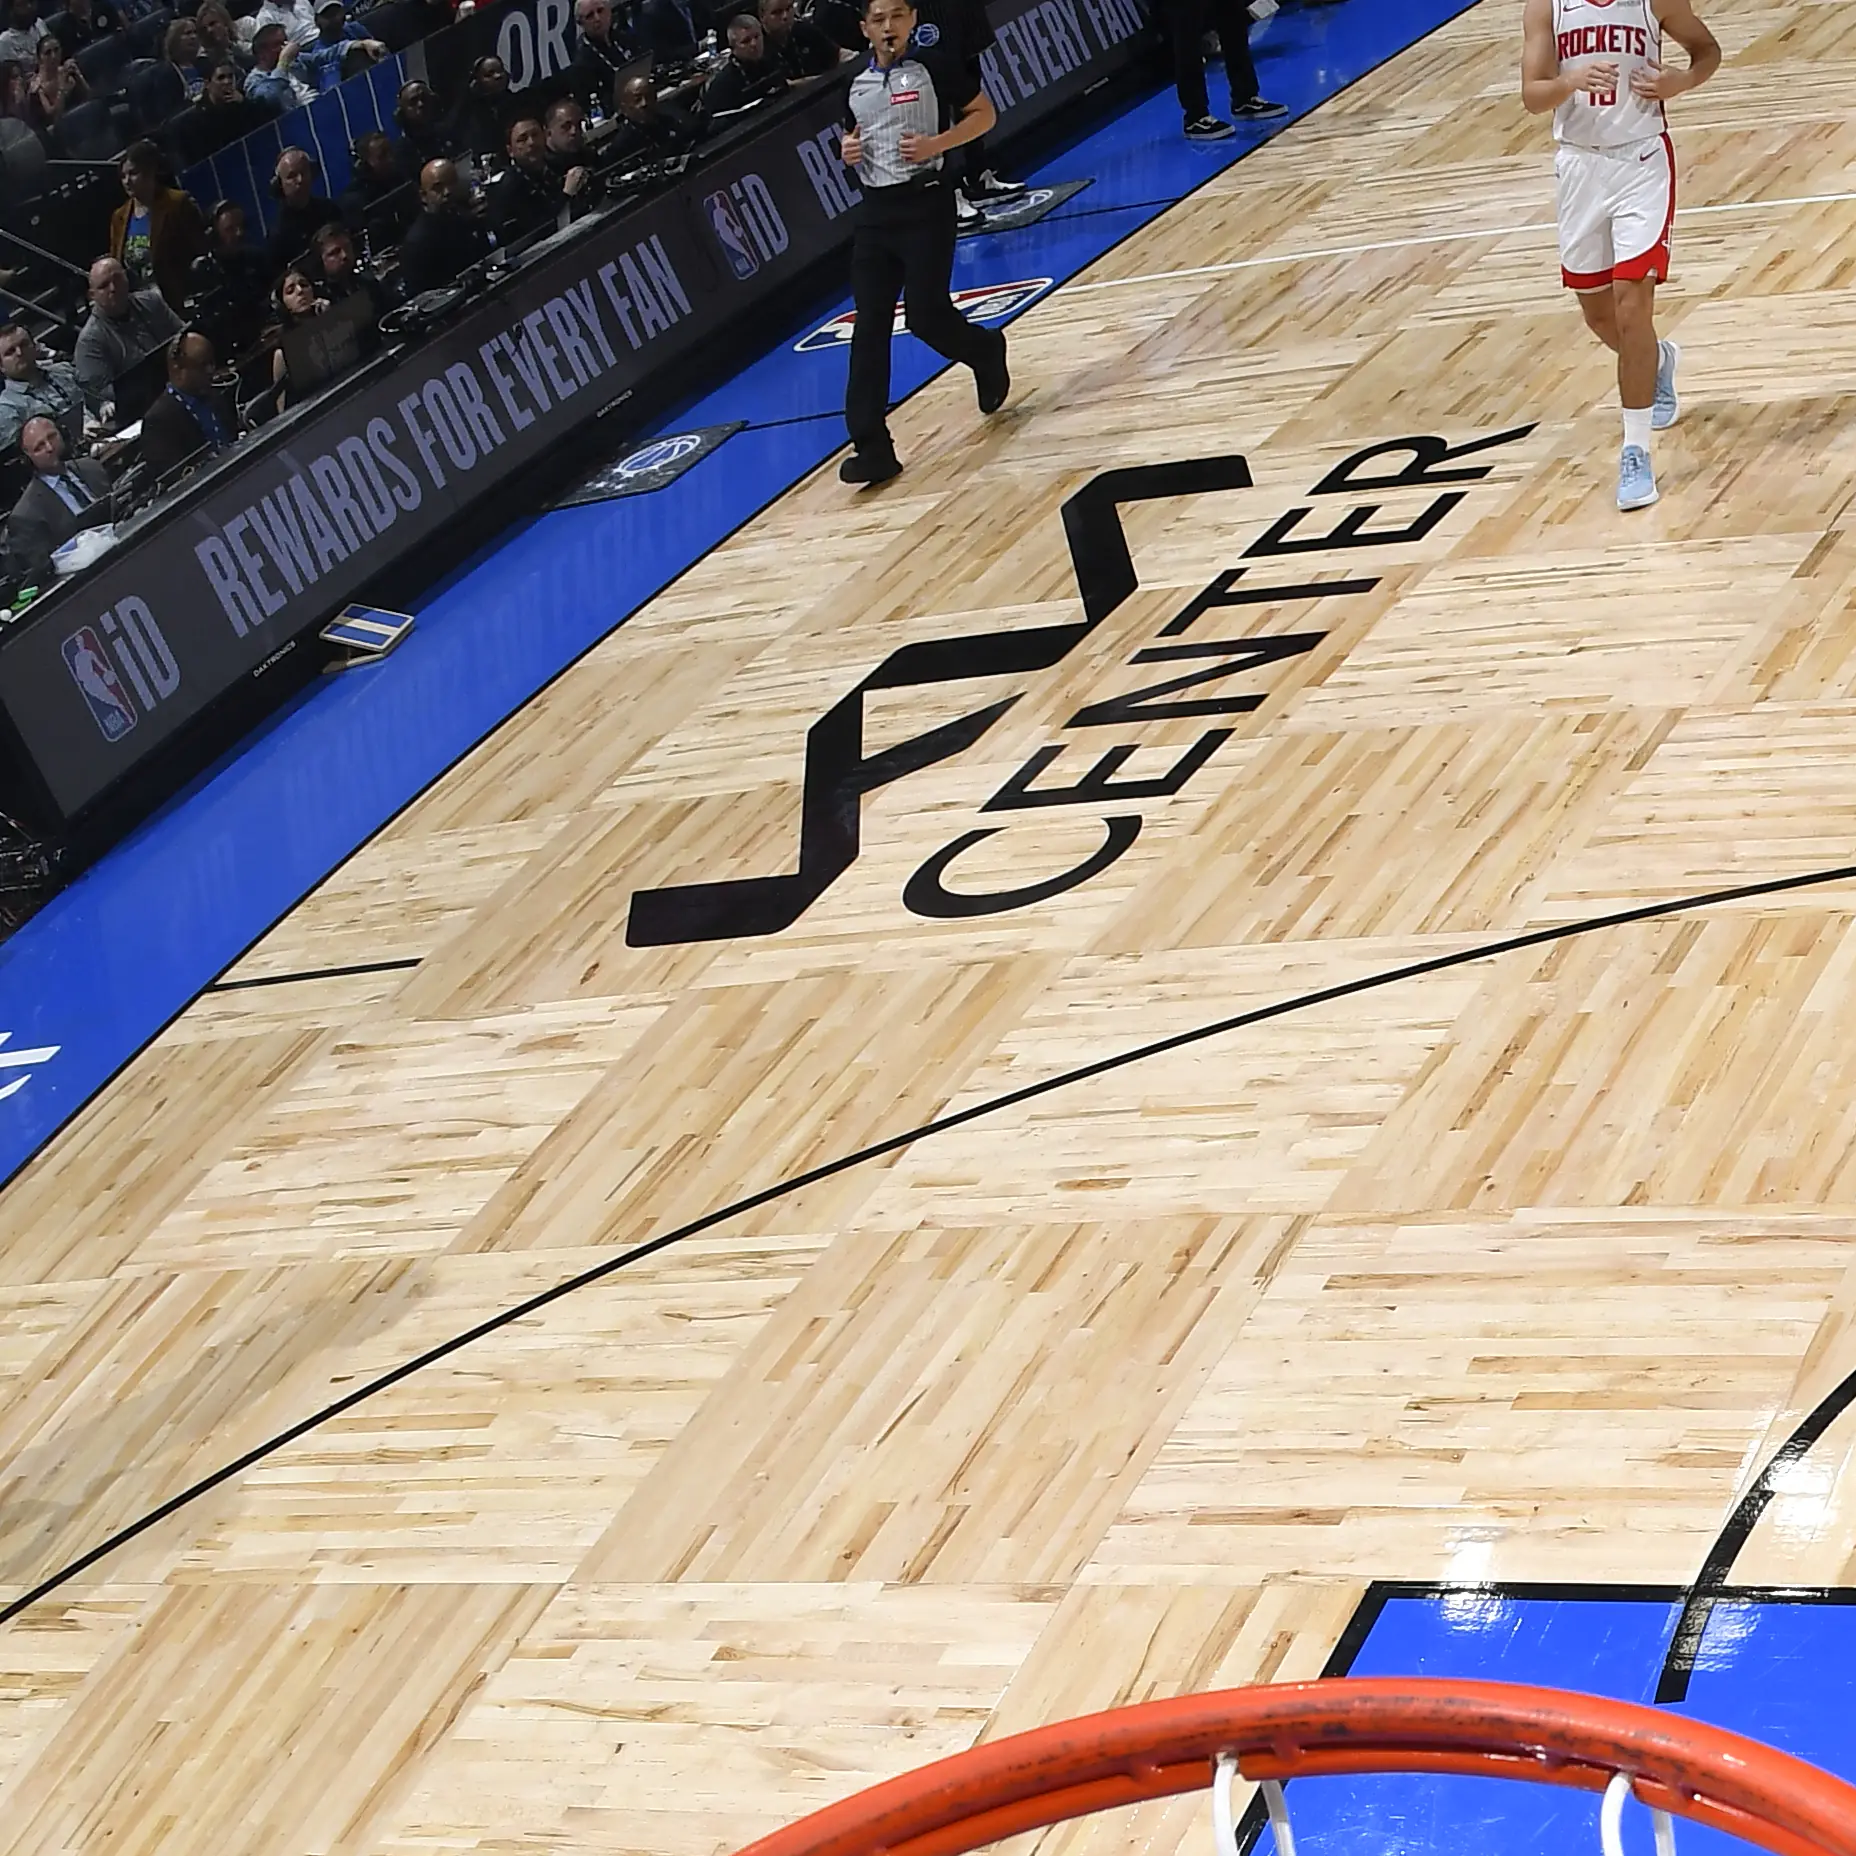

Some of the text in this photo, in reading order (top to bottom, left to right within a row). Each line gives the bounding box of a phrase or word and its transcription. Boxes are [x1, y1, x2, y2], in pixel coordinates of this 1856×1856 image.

[1558, 24, 1647, 60] ROCKETS
[194, 234, 692, 637] REWARDS FOR EVERY FAN
[903, 422, 1539, 918] CENTER
